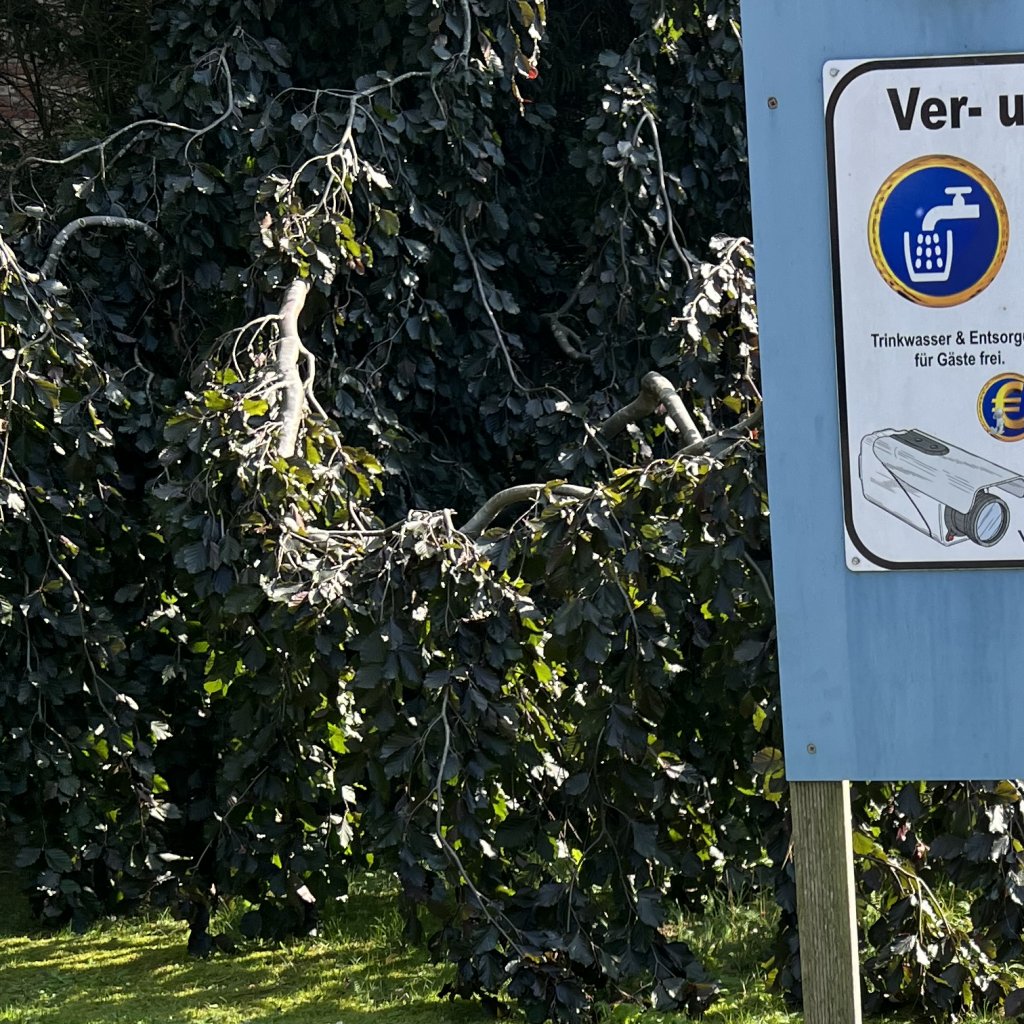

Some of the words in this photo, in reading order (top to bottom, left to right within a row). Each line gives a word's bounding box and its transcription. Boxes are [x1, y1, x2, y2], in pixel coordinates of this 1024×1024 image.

[887, 87, 983, 131] Ver-
[870, 332, 951, 348] Trinkwasser
[955, 331, 965, 345] &
[914, 352, 934, 368] für
[937, 351, 976, 367] Gäste
[979, 350, 1005, 366] frei.
